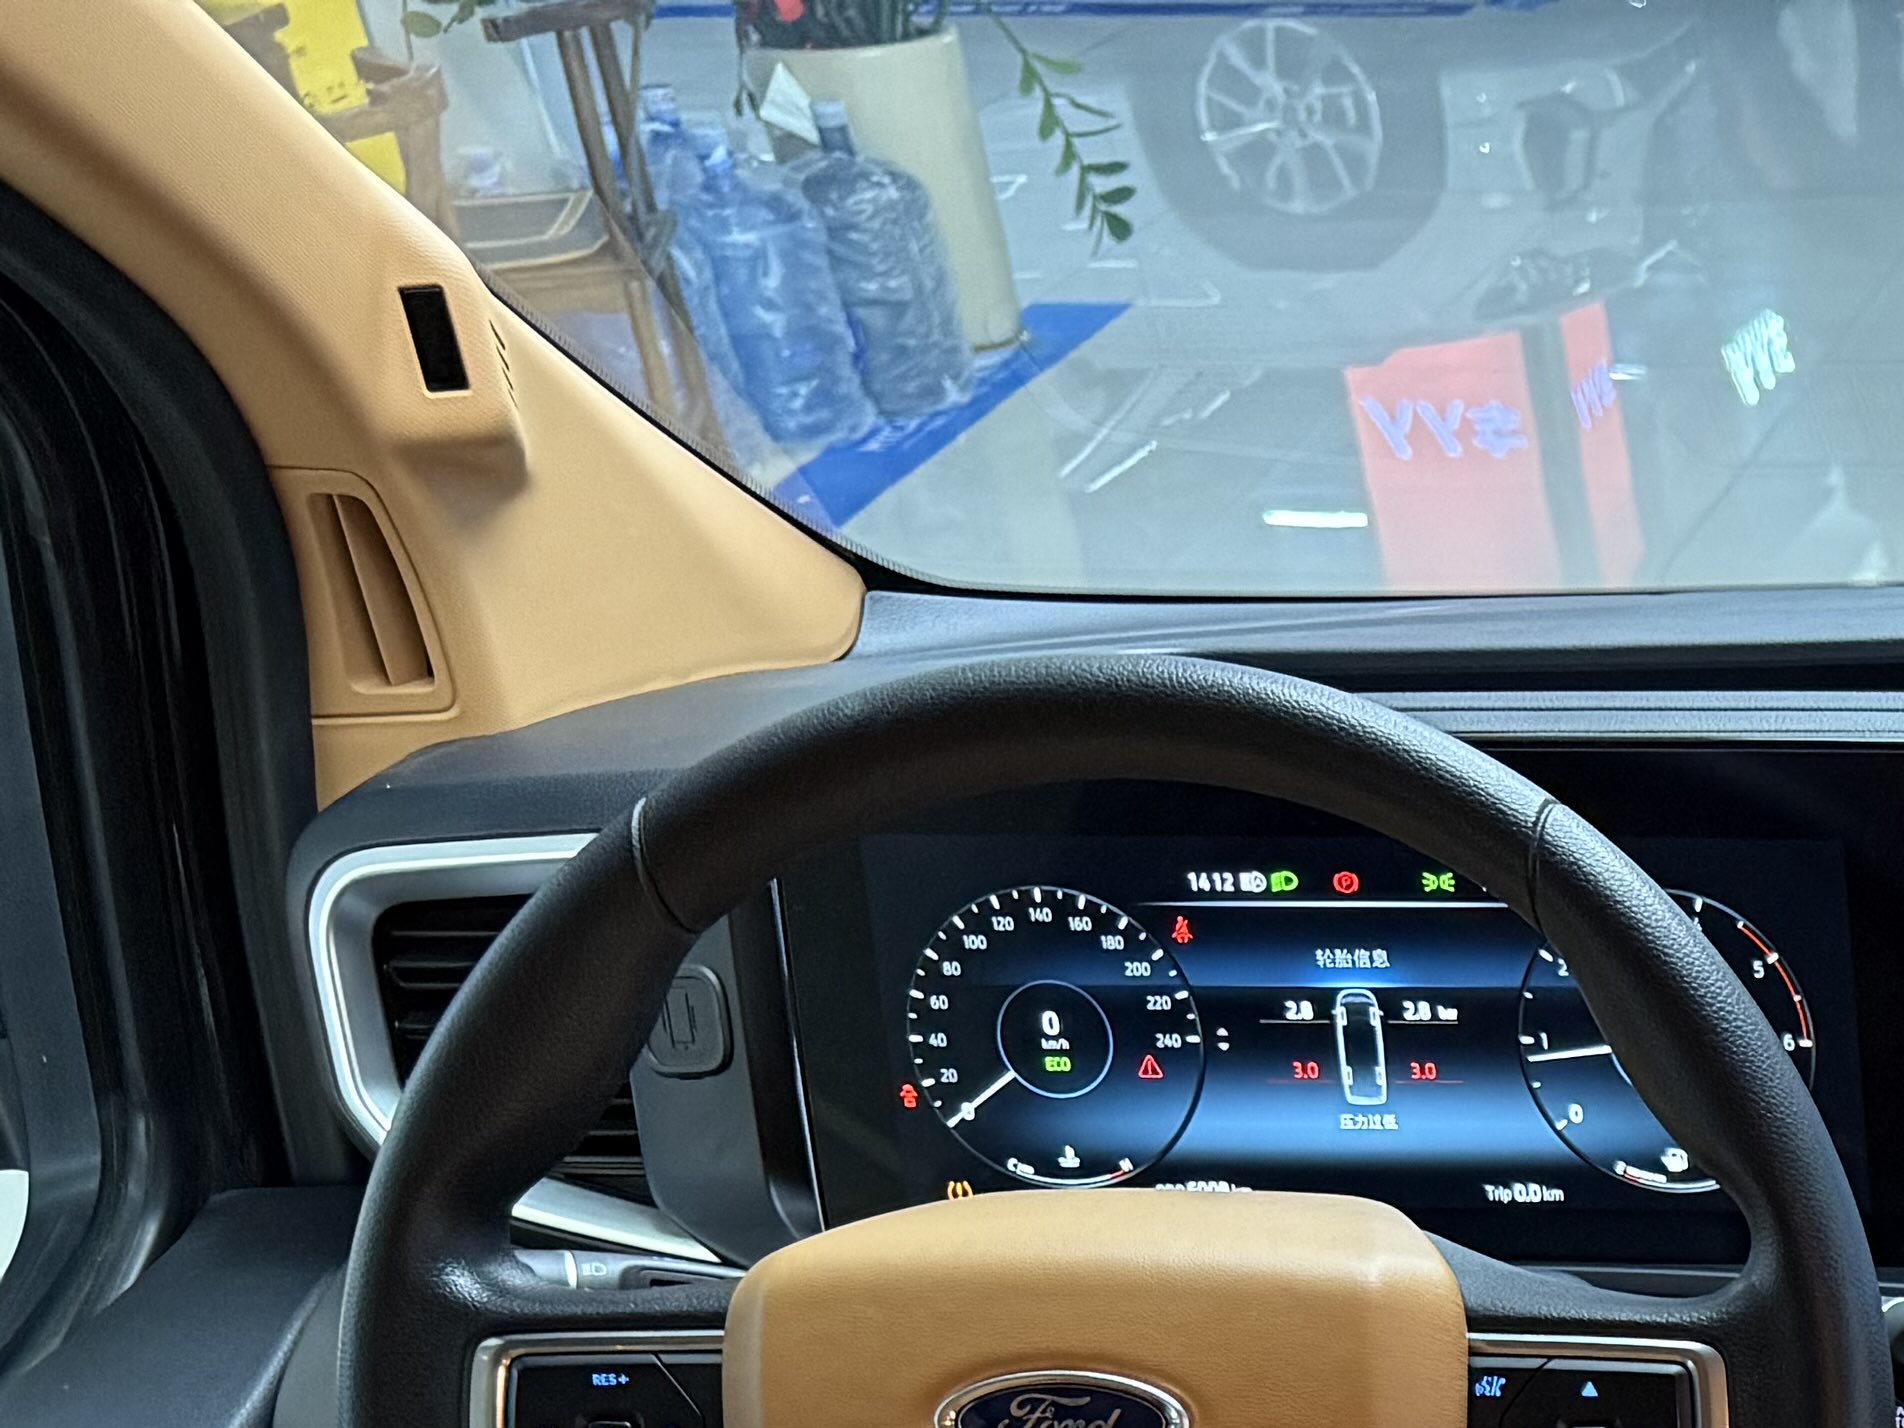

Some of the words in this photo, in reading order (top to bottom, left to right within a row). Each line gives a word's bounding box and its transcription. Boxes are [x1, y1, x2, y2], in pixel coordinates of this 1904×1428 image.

[1028, 907, 1052, 922] 140
[991, 916, 1015, 931] 120
[1068, 916, 1092, 931] 160
[962, 934, 988, 950] 100
[1100, 934, 1125, 950] 180
[1315, 948, 1391, 968] 轮胎信息
[942, 961, 962, 976] 80
[1124, 962, 1151, 977] 200
[1752, 960, 1766, 979] 5
[929, 995, 949, 1010] 60
[1145, 995, 1172, 1010] 220
[1041, 1010, 1061, 1036] 0
[928, 1033, 948, 1047] 40
[1155, 1033, 1182, 1048] 240
[1539, 1031, 1549, 1050] 1
[1782, 1033, 1796, 1051] 6
[1044, 1056, 1072, 1072] ECO
[1292, 1061, 1320, 1080] 3.0
[1410, 1061, 1438, 1080] 3.0
[940, 1068, 958, 1083] 20
[1568, 1103, 1584, 1124] 0
[1482, 1184, 1513, 1204] Trip
[1513, 1182, 1542, 1203] 0.0
[1542, 1185, 1565, 1202] km
